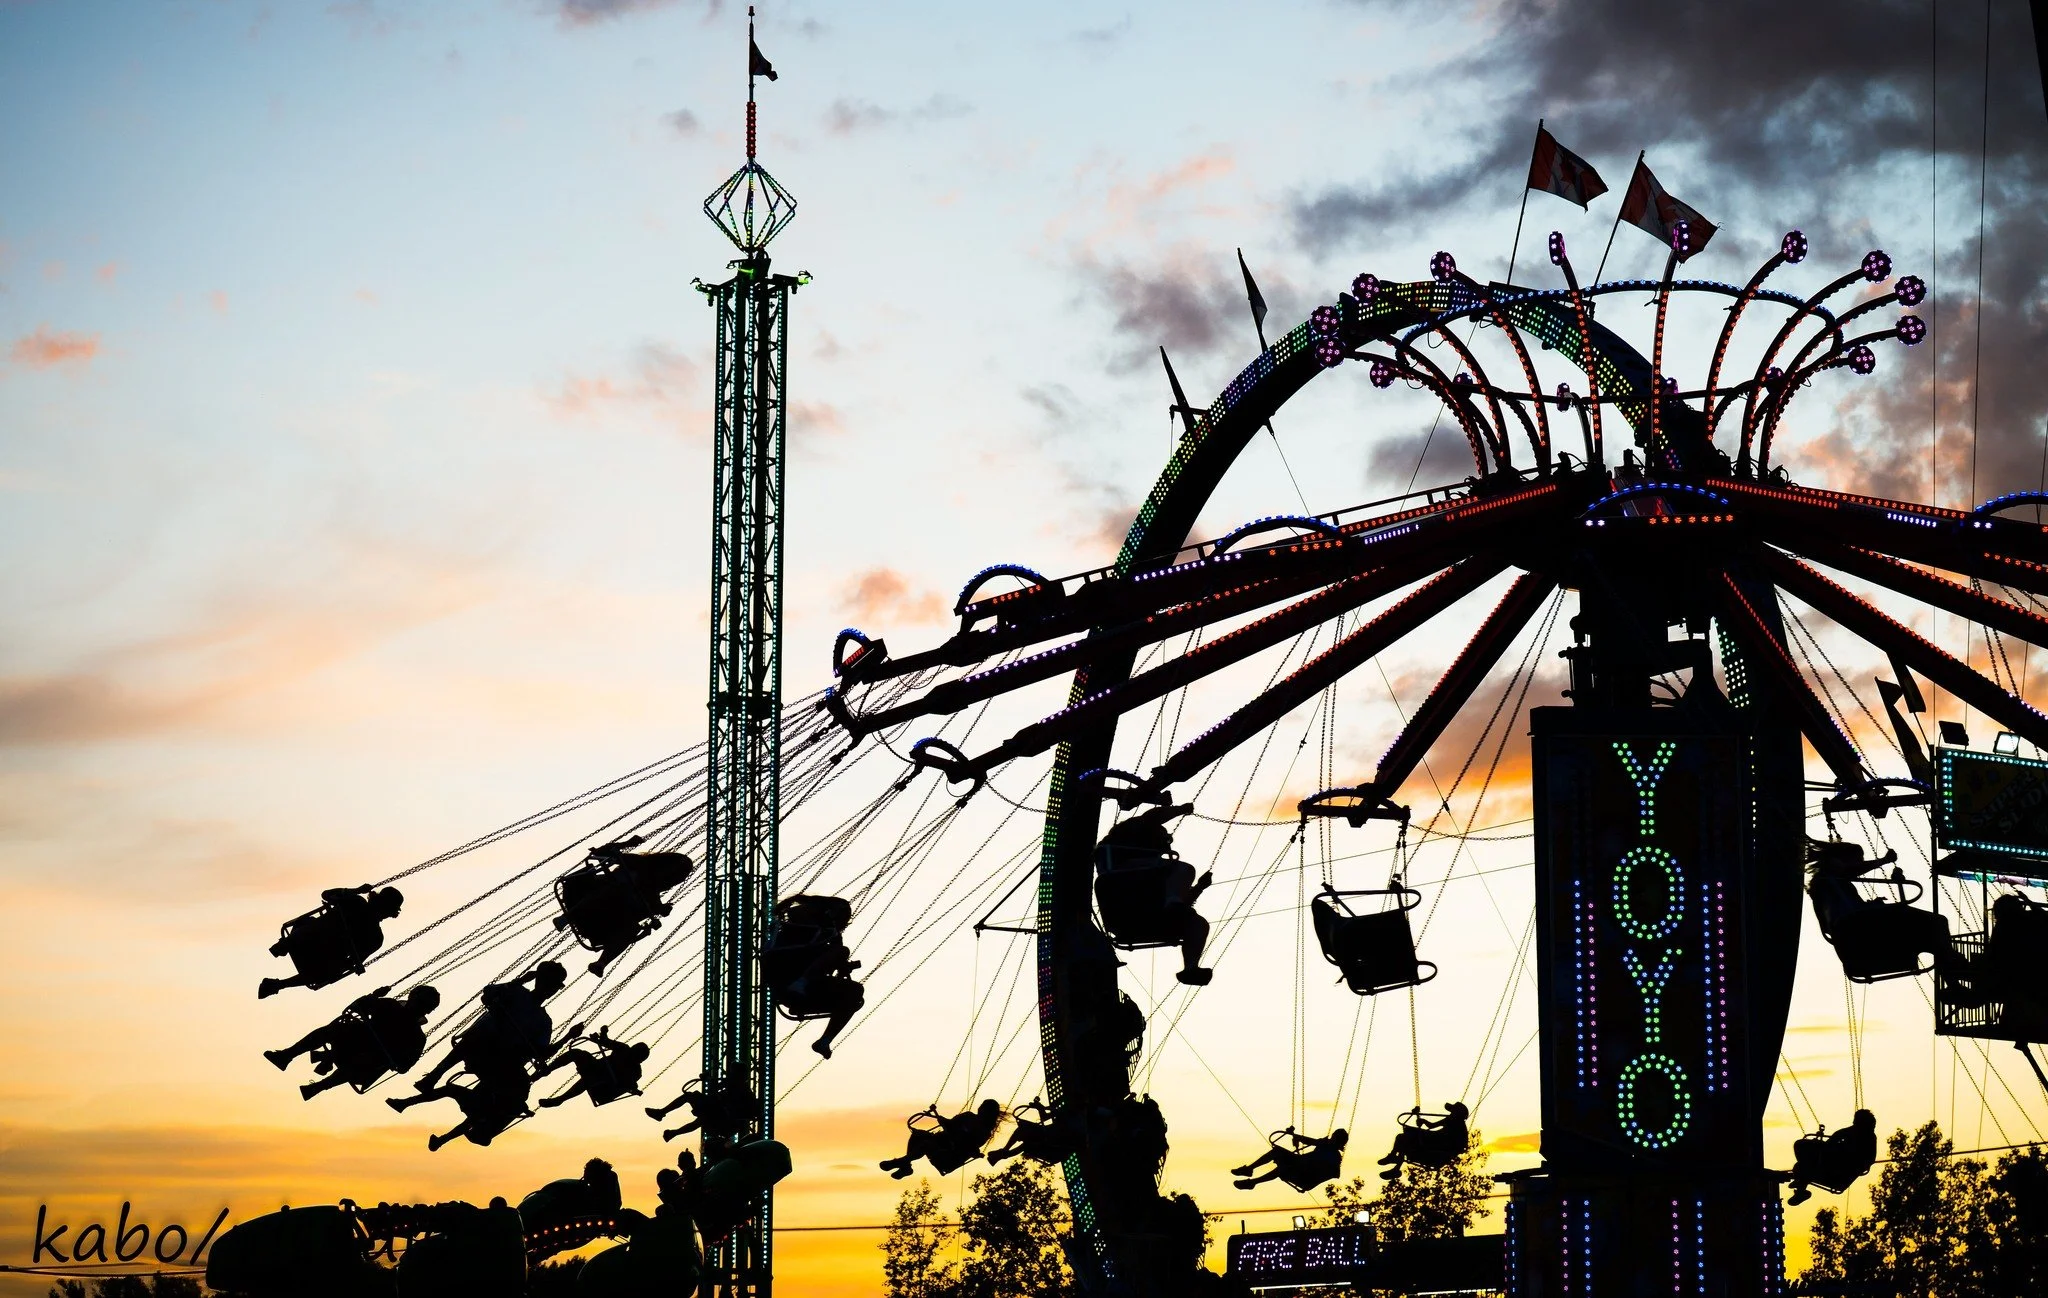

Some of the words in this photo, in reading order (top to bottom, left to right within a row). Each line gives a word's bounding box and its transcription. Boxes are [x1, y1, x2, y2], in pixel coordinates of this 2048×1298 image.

[1610, 741, 1693, 1150] YOYO
[1238, 1238, 1296, 1272] FIRE
[1304, 1235, 1367, 1268] BALL
